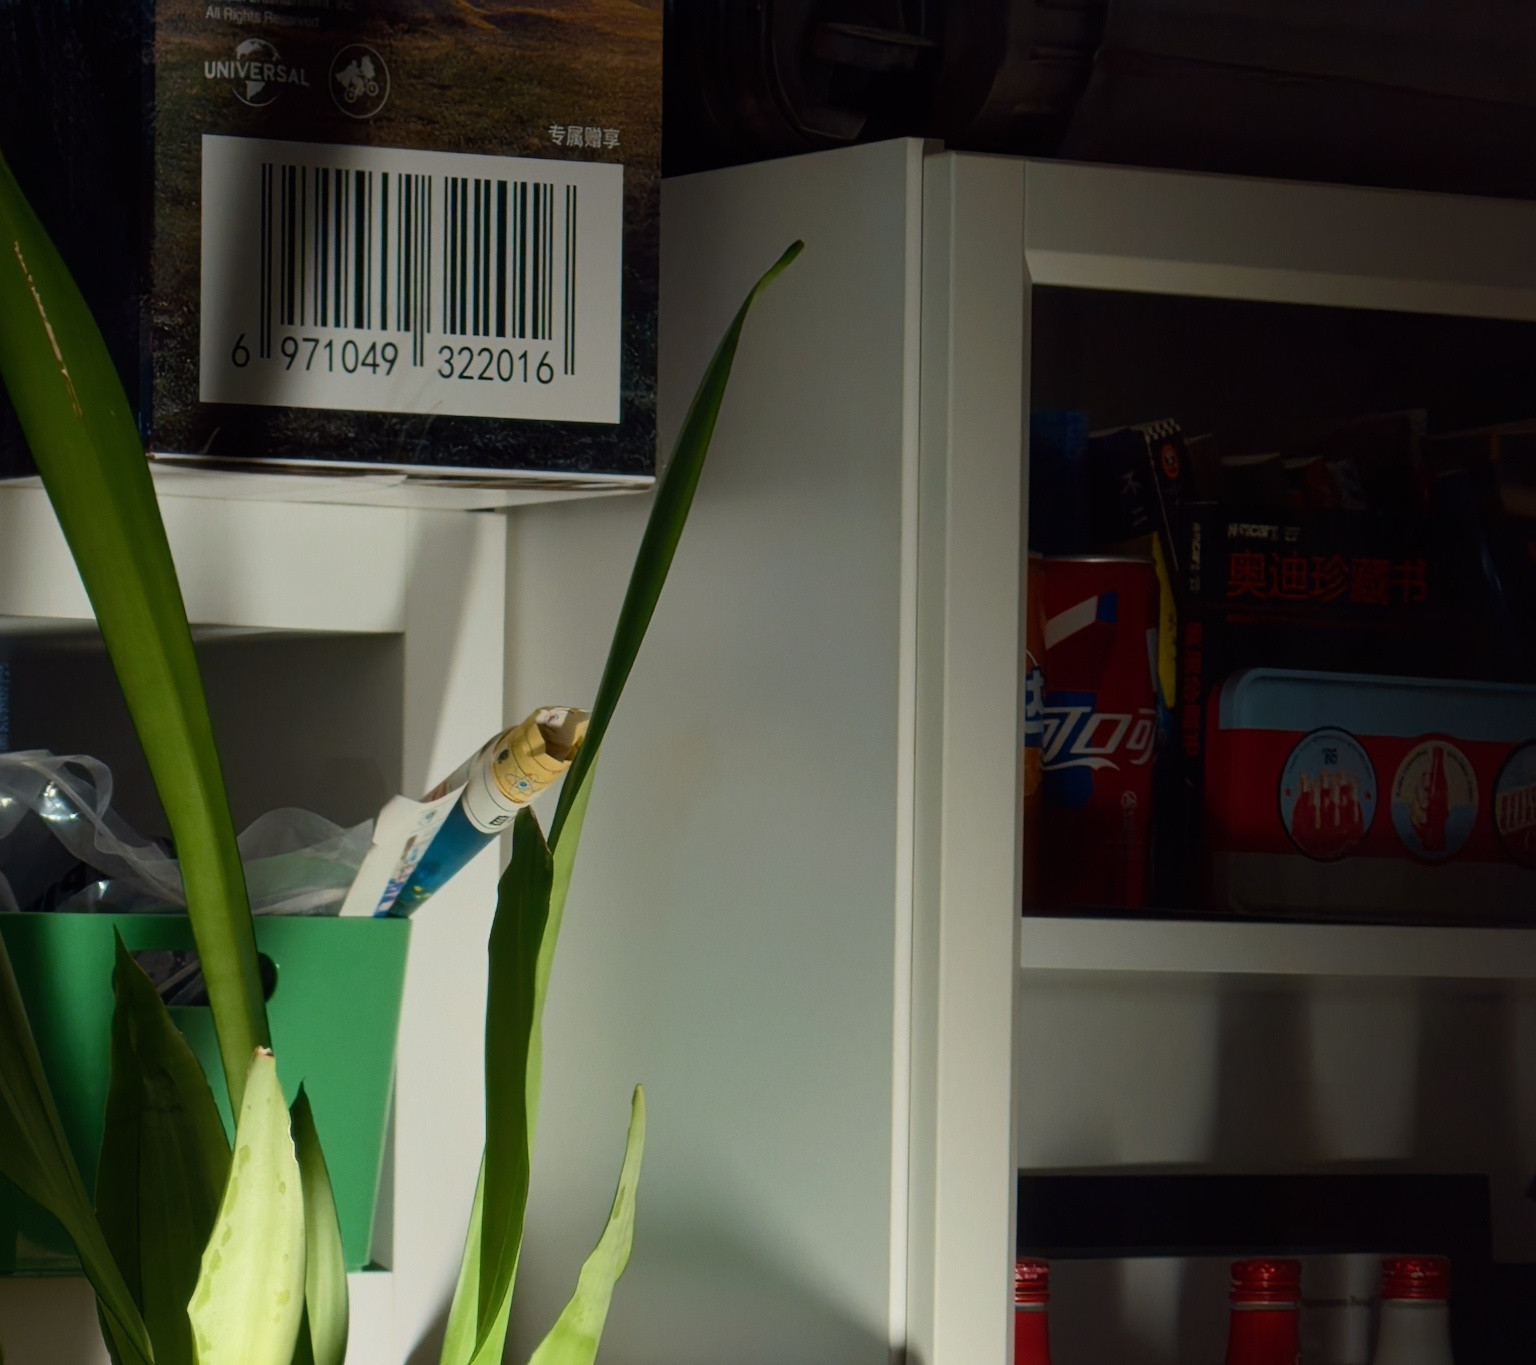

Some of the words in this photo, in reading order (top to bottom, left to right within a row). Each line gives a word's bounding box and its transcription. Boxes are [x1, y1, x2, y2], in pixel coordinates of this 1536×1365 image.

[205, 6, 221, 19] All
[204, 60, 310, 87] UNIVERSAL
[548, 124, 620, 150] 专属赠享
[231, 334, 250, 368] 6
[280, 336, 399, 376] 971049
[437, 345, 555, 385] 322016
